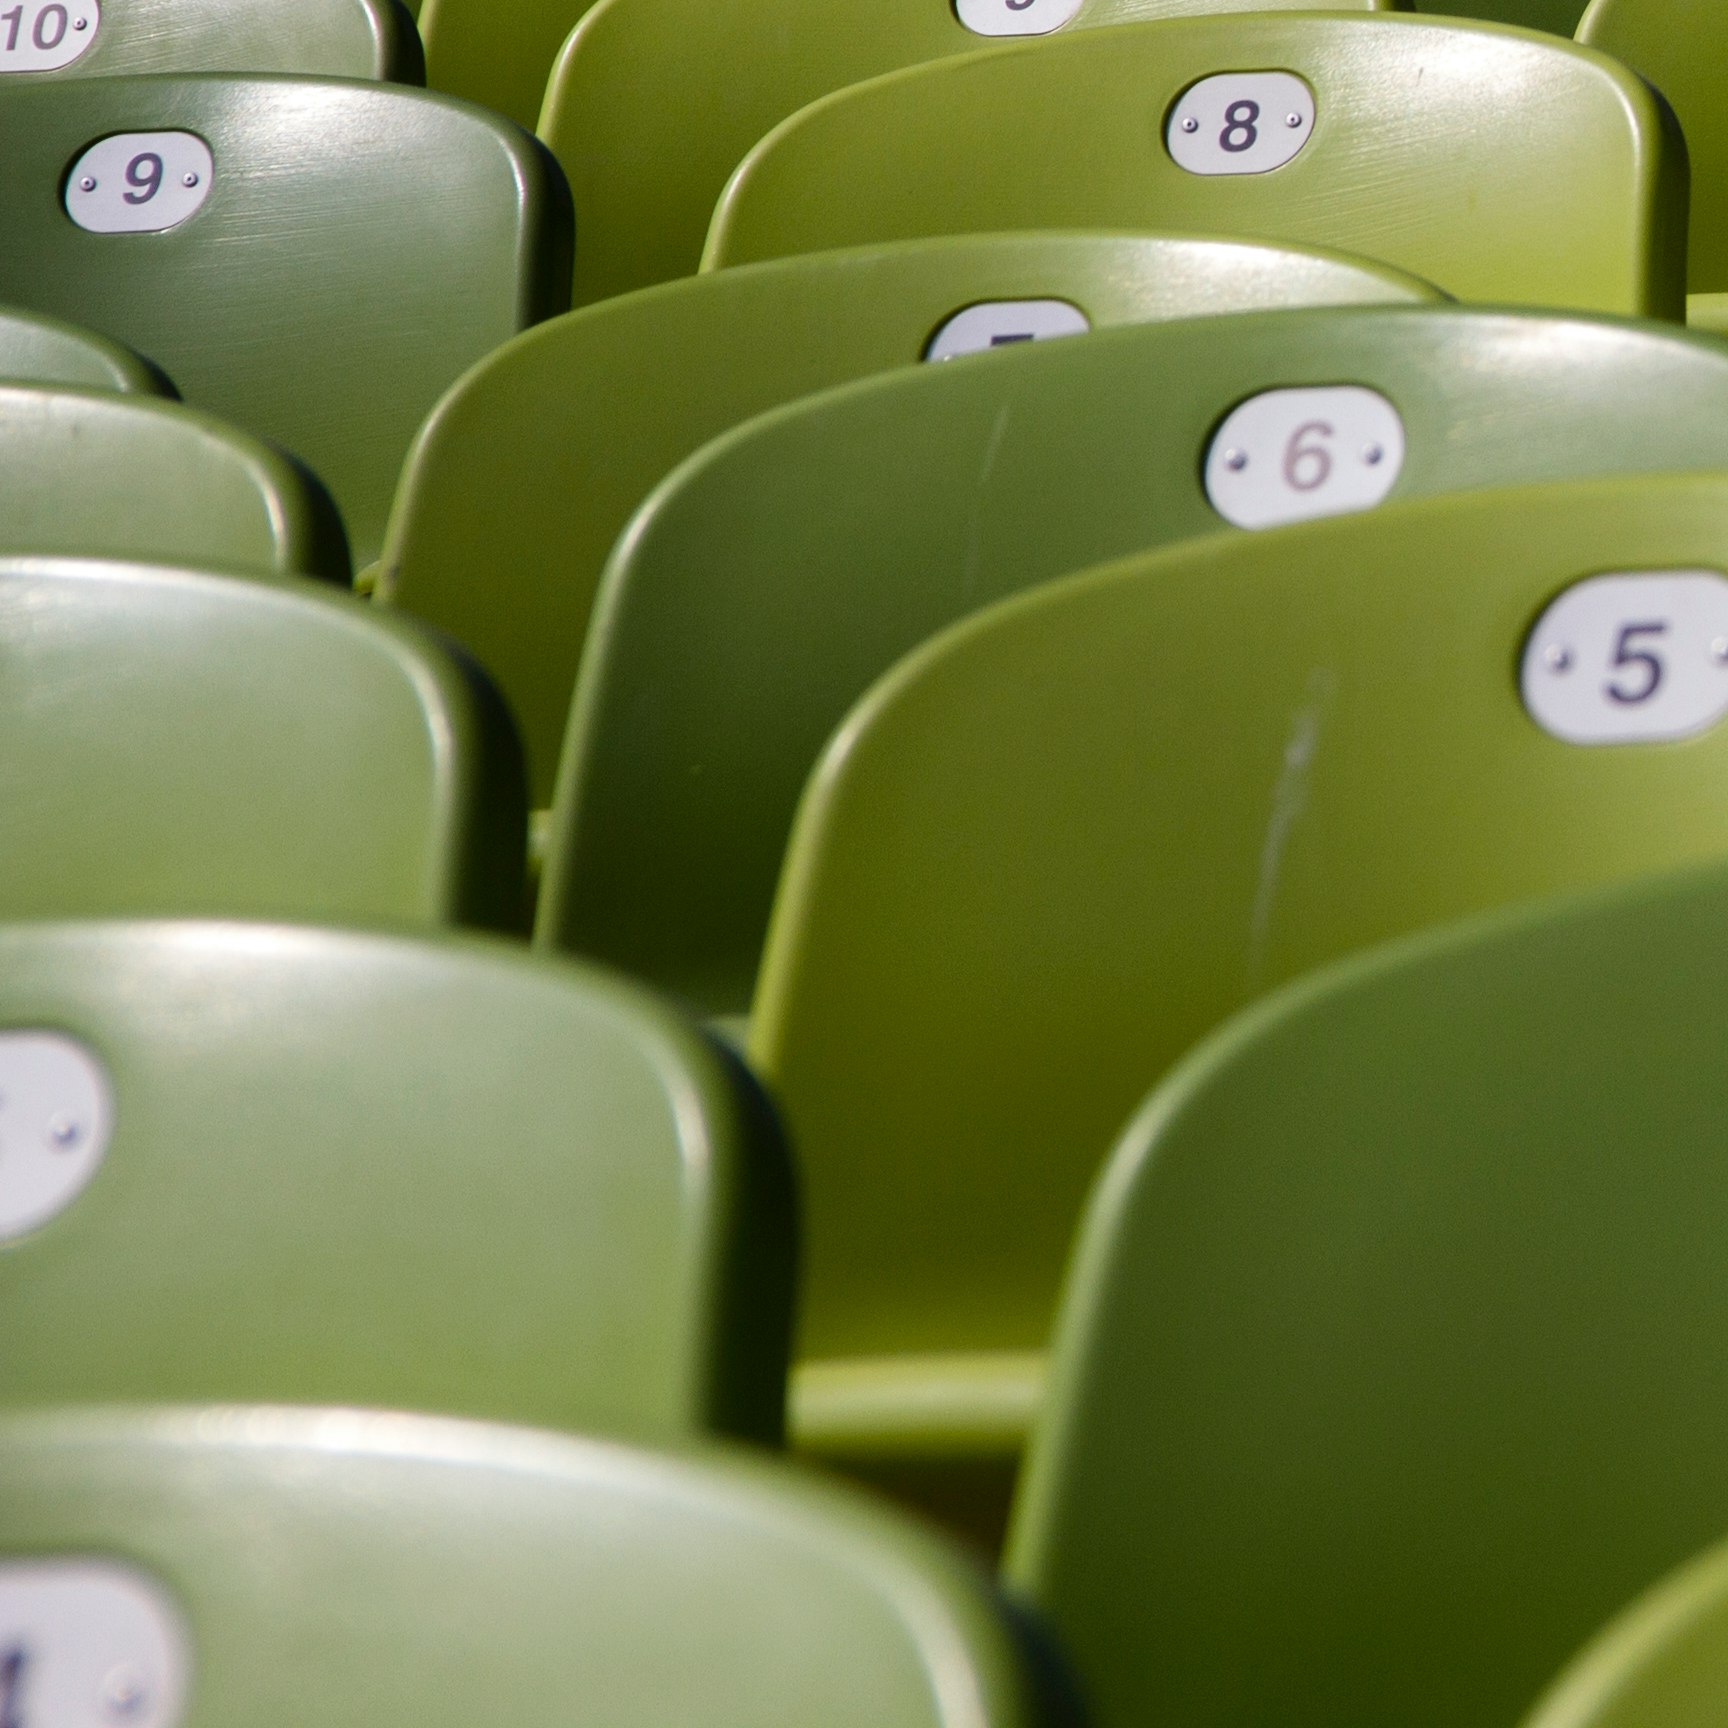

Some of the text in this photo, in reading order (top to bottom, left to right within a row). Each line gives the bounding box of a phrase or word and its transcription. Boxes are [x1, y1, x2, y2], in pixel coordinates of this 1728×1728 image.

[0, 4, 68, 51] 10
[1218, 99, 1261, 153] 8
[122, 152, 164, 206] 9
[1282, 419, 1335, 494] 6
[1604, 621, 1668, 708] 5
